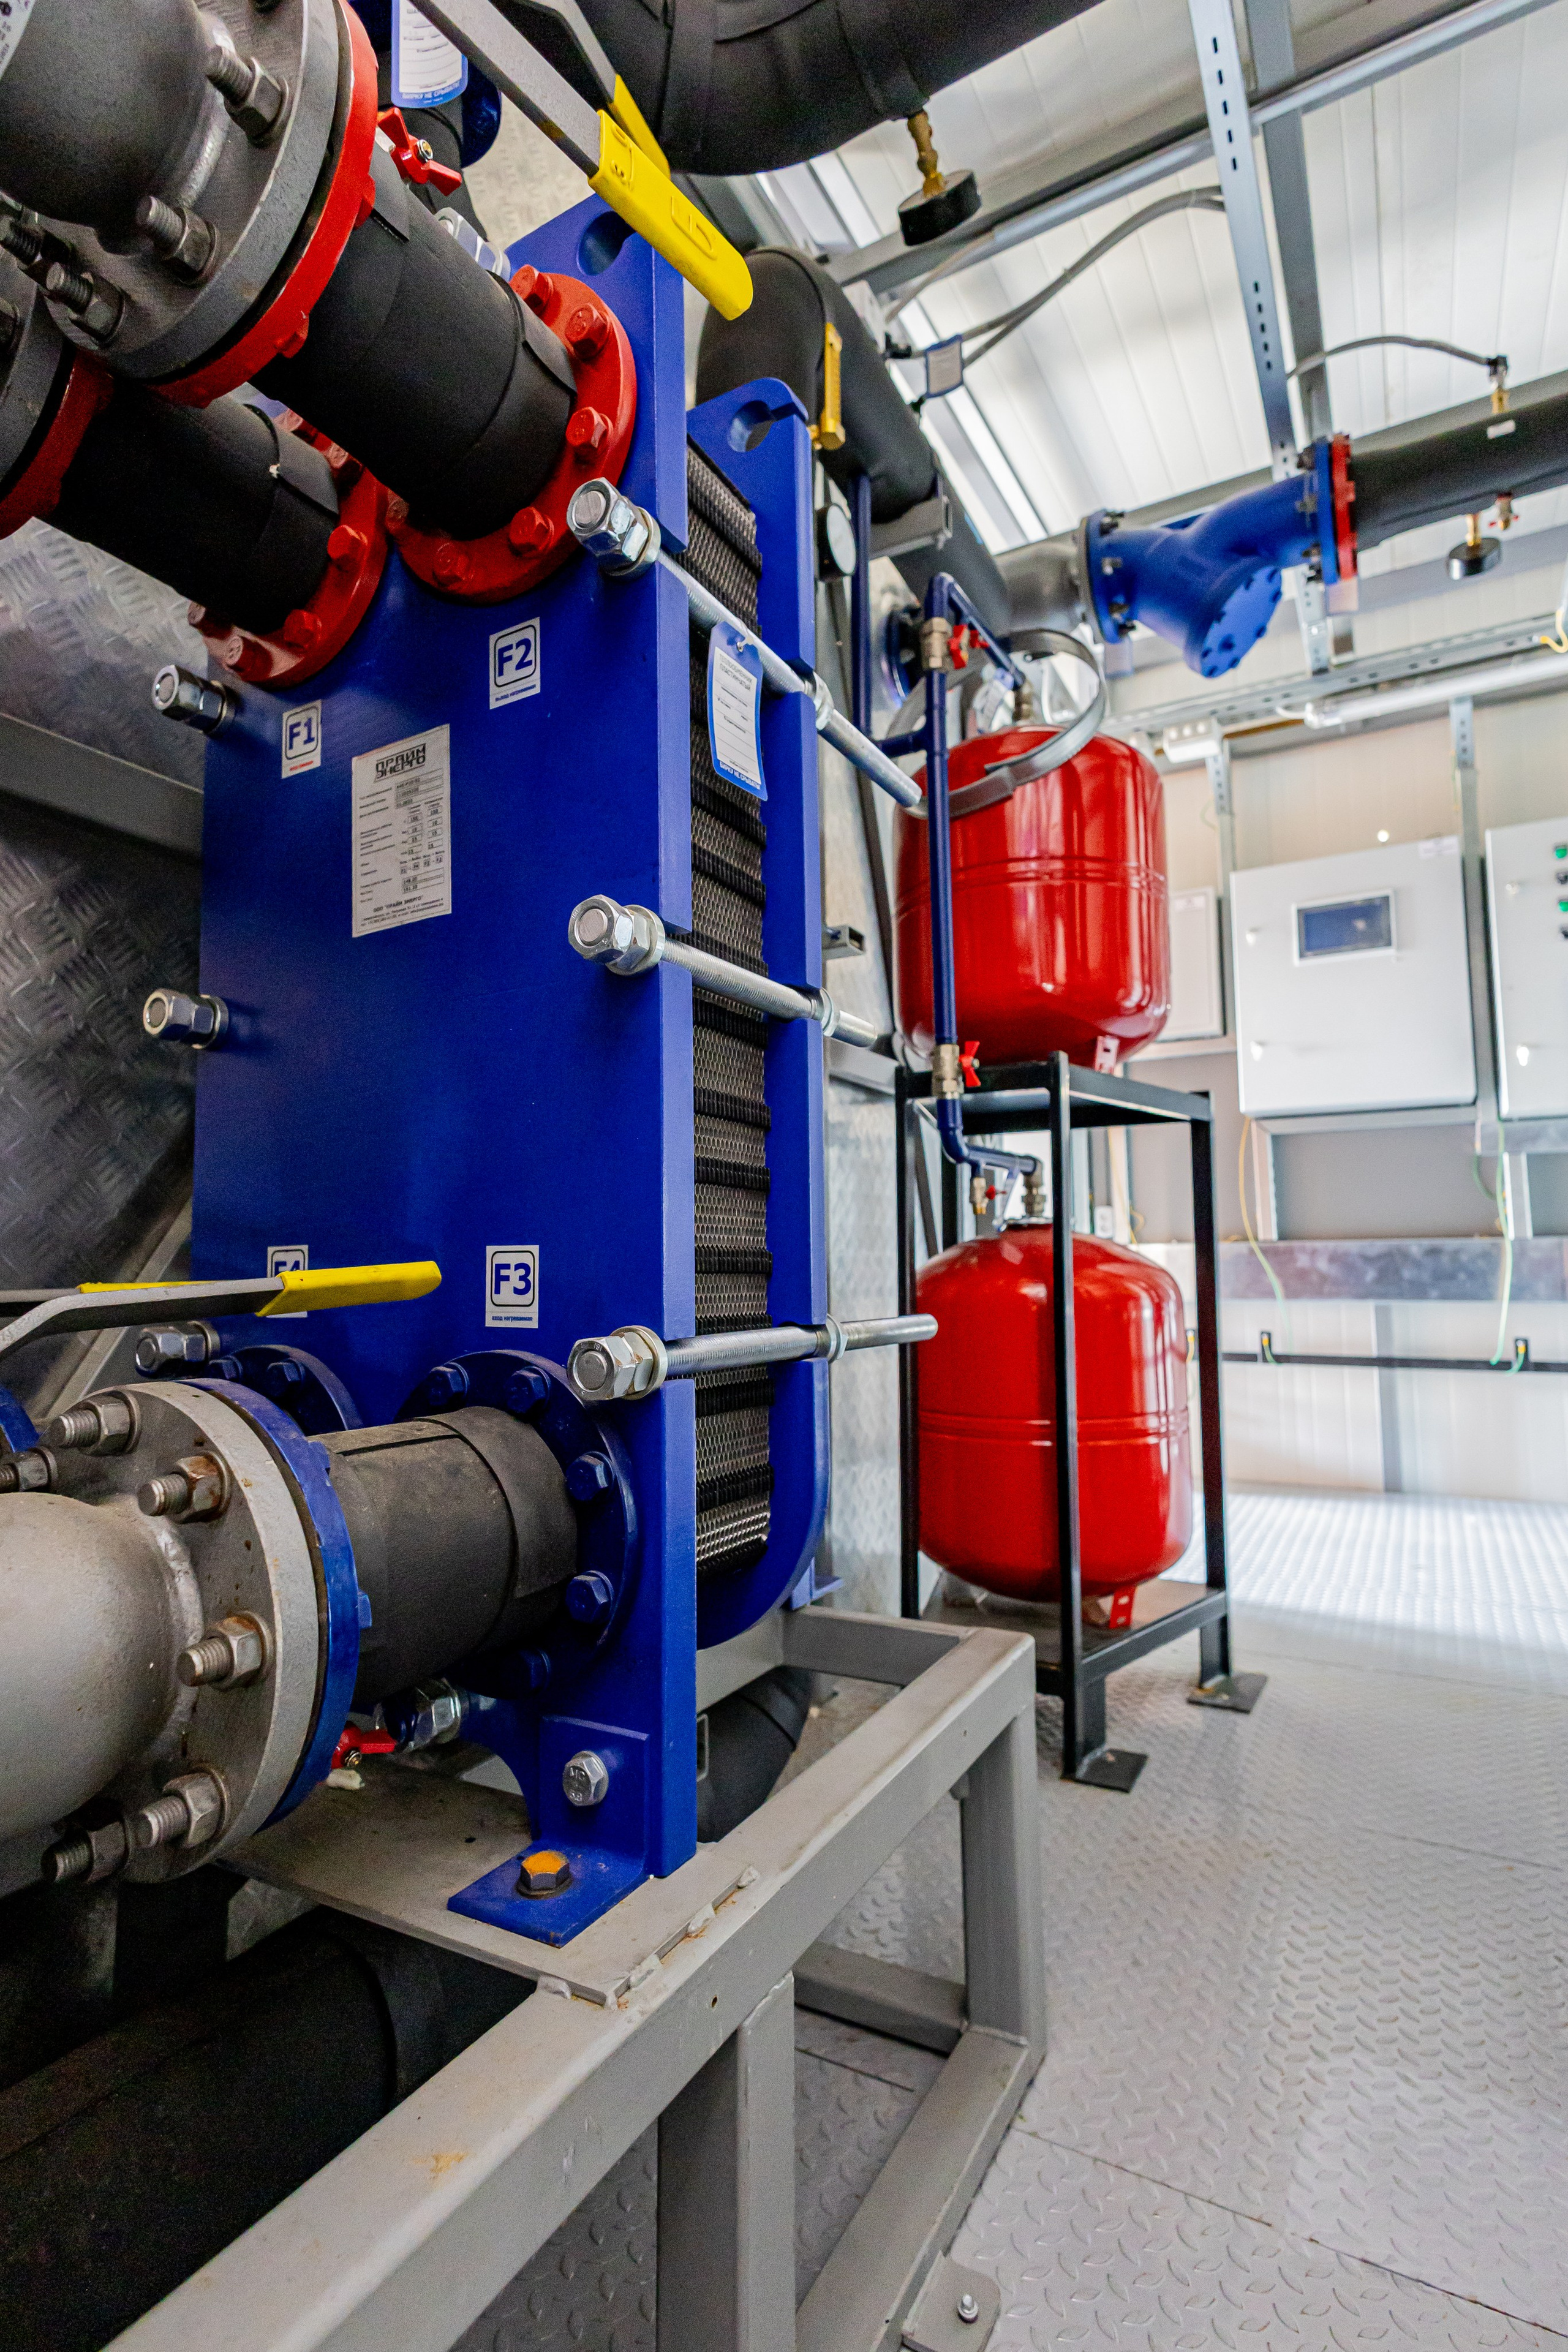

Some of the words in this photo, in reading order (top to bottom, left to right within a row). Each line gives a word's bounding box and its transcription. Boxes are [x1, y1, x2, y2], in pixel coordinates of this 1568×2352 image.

[498, 638, 533, 677] F2
[288, 717, 315, 750] F1
[494, 1262, 531, 1295] F3
